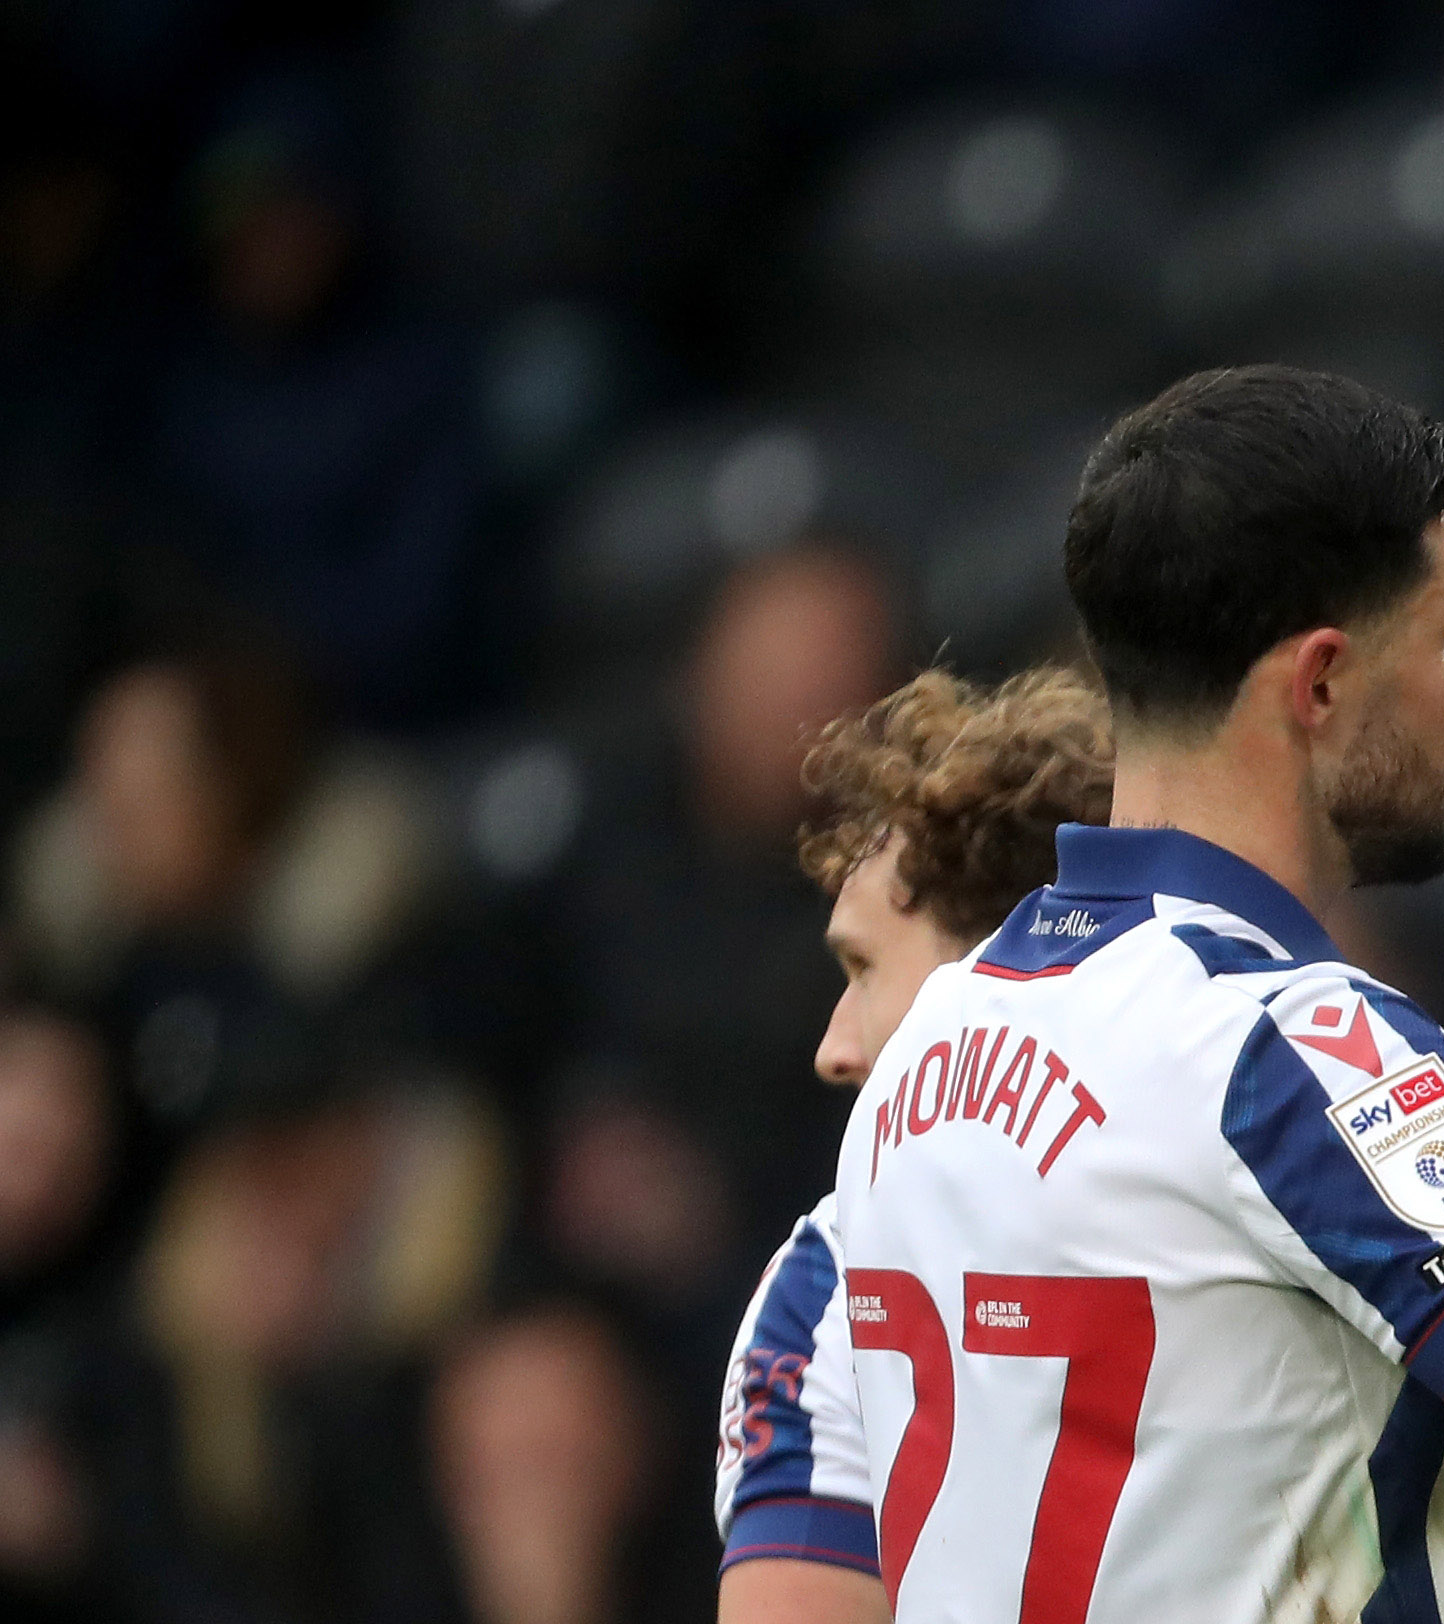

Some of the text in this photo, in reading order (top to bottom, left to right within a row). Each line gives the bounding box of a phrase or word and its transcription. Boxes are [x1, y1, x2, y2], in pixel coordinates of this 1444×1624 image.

[869, 1025, 1107, 1189] MOWATT
[1350, 1074, 1443, 1136] sky bet
